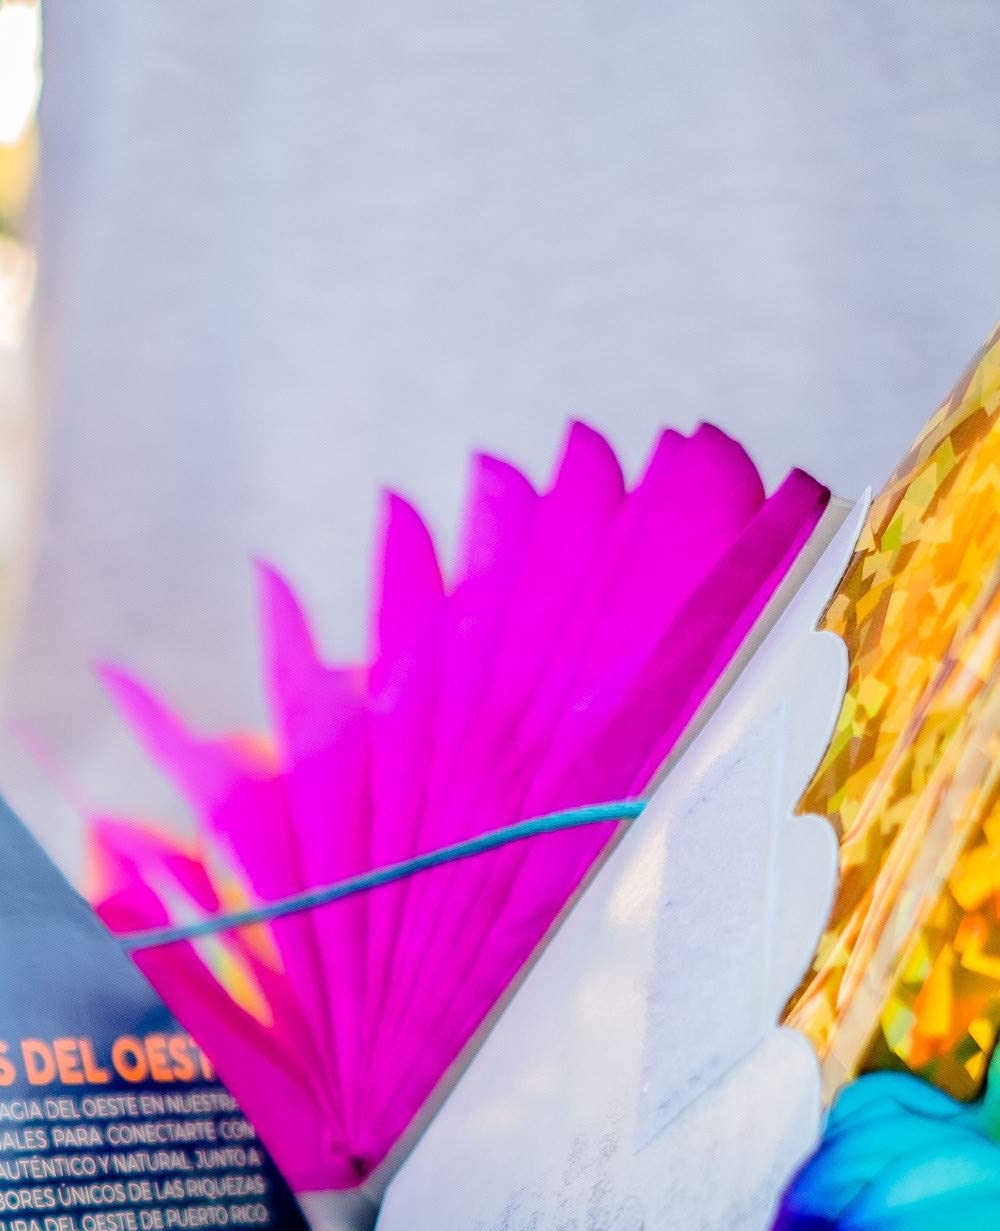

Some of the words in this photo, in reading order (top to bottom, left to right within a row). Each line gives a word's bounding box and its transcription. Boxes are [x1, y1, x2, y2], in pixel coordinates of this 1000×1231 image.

[21, 1037, 111, 1086] DEL
[47, 1097, 80, 1119] DEL
[83, 1095, 138, 1118] OESTE
[141, 1095, 165, 1116] EN
[53, 1126, 103, 1148] PARA
[107, 1121, 216, 1145] CONECTARTE
[98, 1156, 111, 1175] Y
[195, 1147, 247, 1169] JUNTO
[248, 1148, 262, 1167] A
[58, 1183, 126, 1208] ÚNICOS
[129, 1181, 154, 1203] DE
[156, 1179, 185, 1200] LAS
[186, 1176, 266, 1200] RIQUEZAS
[141, 1209, 165, 1230] DE
[166, 1206, 228, 1228] PUERTO
